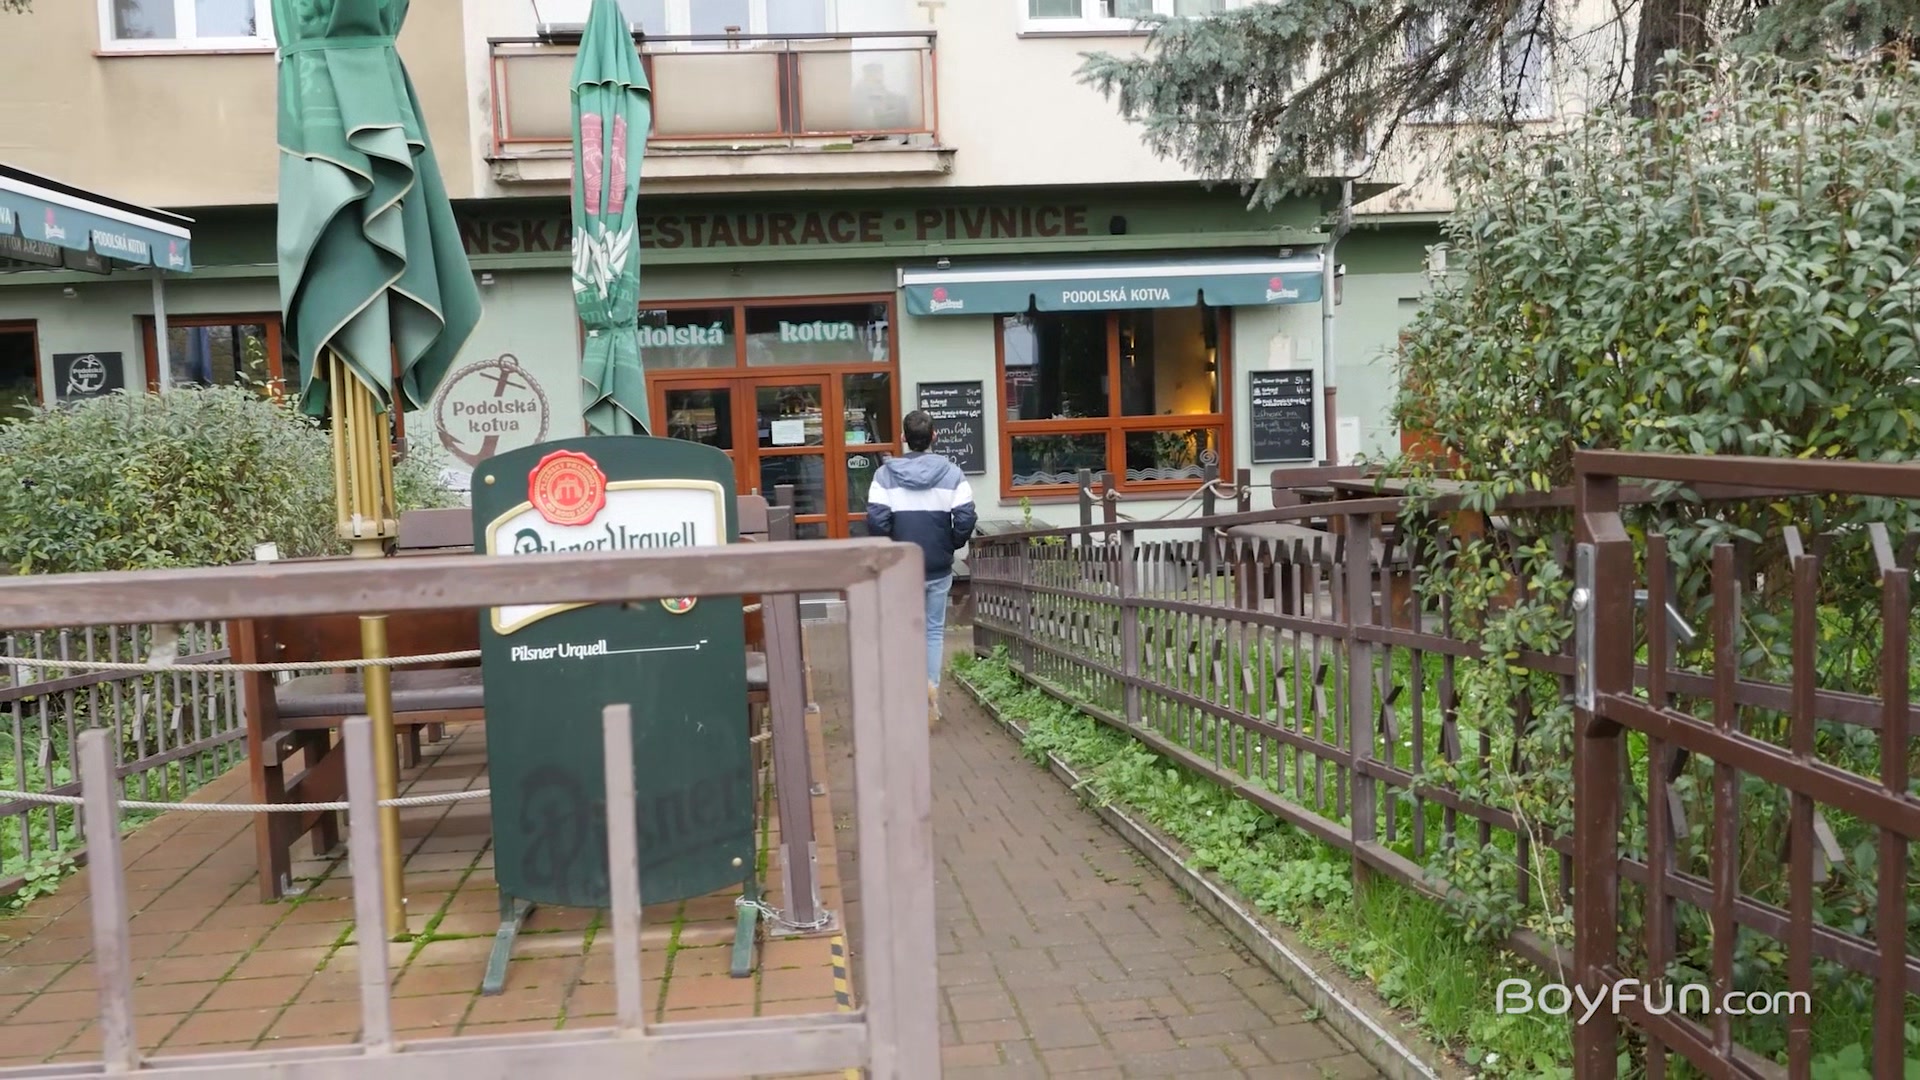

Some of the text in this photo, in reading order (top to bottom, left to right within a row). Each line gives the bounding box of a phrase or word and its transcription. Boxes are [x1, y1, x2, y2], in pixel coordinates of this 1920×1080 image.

[639, 210, 883, 249] ESTAURACE
[915, 205, 1088, 240] PIVNICE
[1062, 286, 1170, 303] PODOLSKÁ KOTVA
[638, 320, 854, 347] dolská kotva
[452, 398, 537, 416] Podolská
[468, 418, 519, 433] kotva
[511, 645, 557, 662] Pilsner
[558, 639, 608, 661] Urquell
